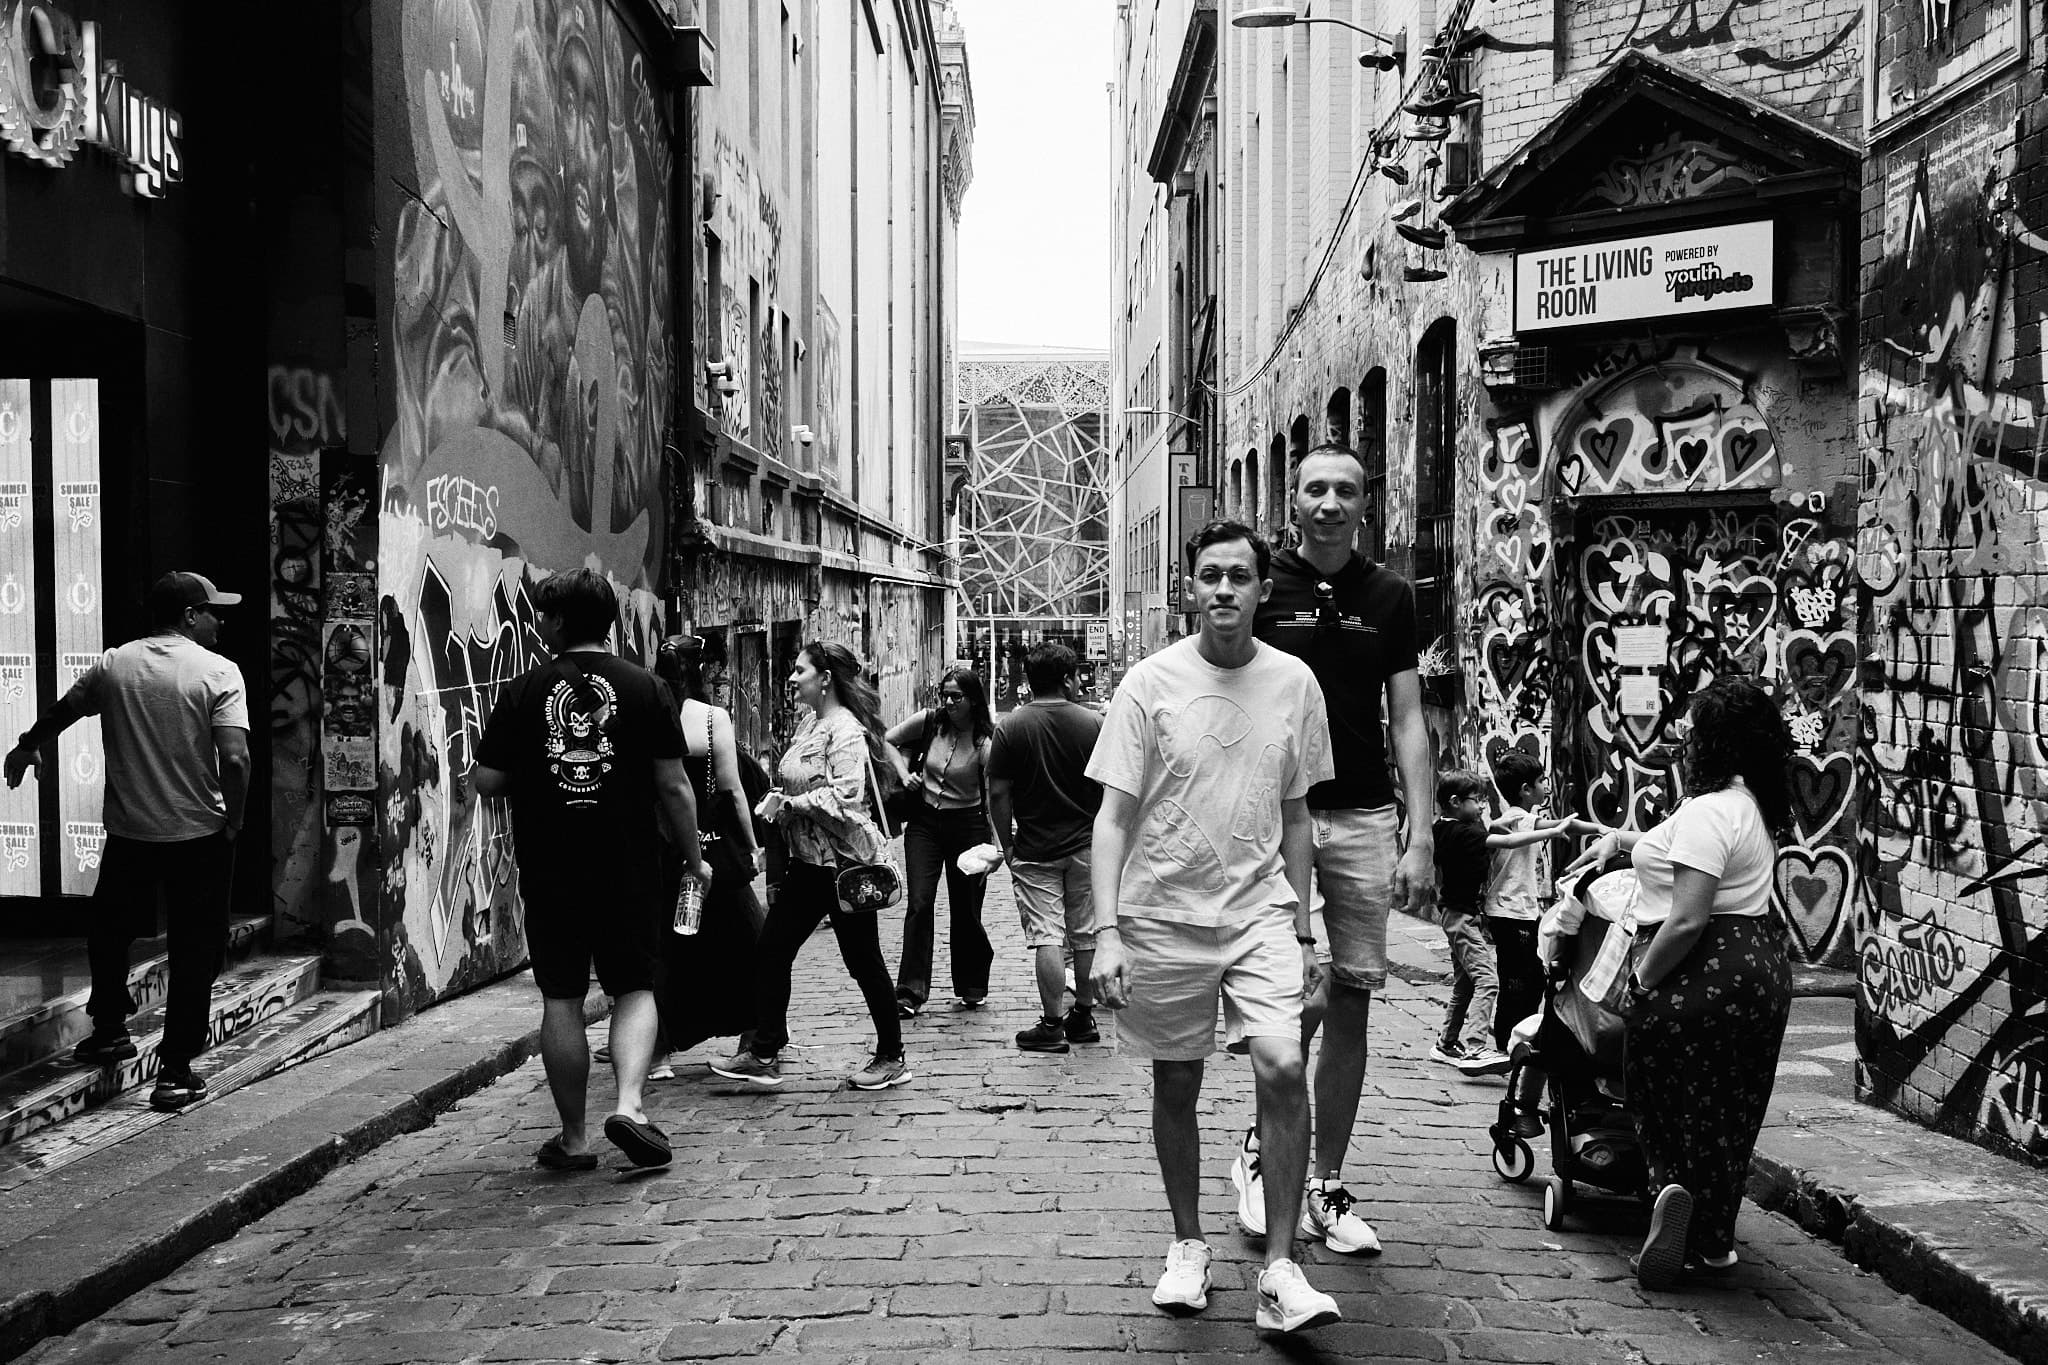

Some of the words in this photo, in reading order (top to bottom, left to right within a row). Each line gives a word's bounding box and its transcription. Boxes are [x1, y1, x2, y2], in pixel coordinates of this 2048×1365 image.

[1665, 246, 1705, 262] POWERED
[1707, 244, 1719, 257] BY
[1537, 256, 1576, 288] THE
[1583, 246, 1653, 283] LIVING
[1665, 262, 1721, 292] youth
[1675, 272, 1753, 302] projects
[1537, 285, 1597, 320] ROOM
[0, 484, 27, 494] MMER
[61, 484, 98, 494] SUMMER
[70, 497, 90, 507] SALE
[1126, 610, 1135, 669] MOVID
[0, 656, 30, 666] UMMER
[2, 668, 22, 678] SALE
[591, 673, 617, 702] THROUGH
[5, 838, 26, 848] SALE
[76, 838, 97, 848] SALE
